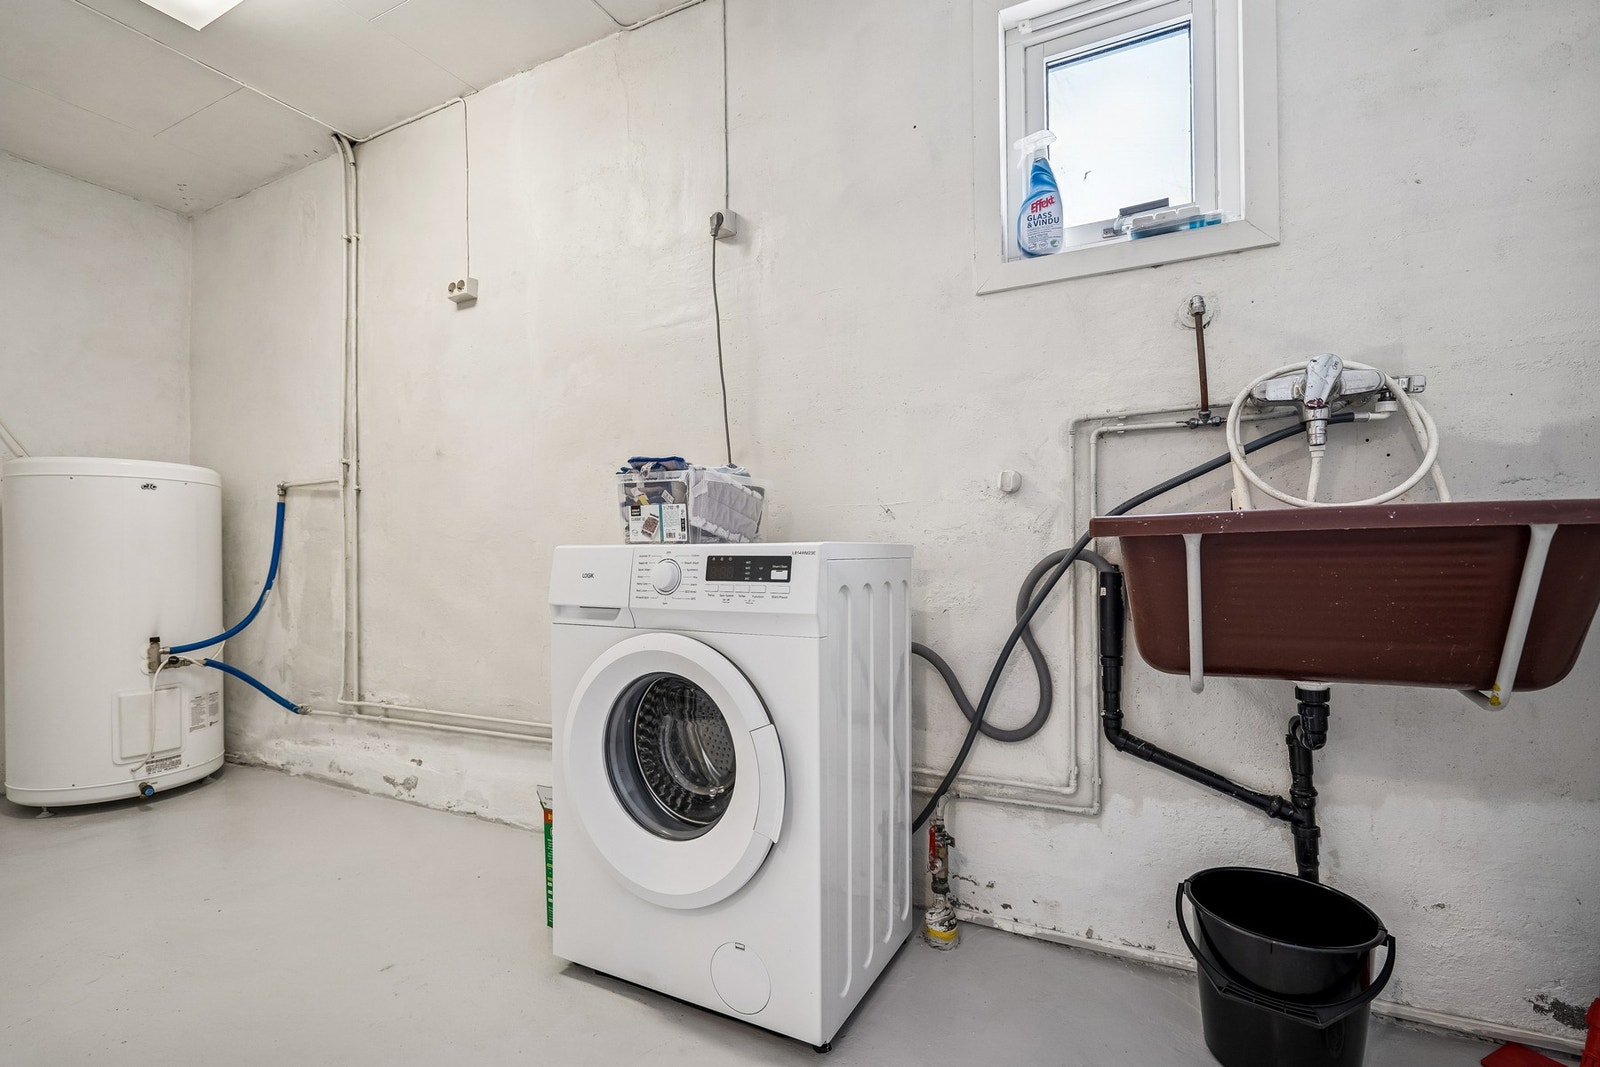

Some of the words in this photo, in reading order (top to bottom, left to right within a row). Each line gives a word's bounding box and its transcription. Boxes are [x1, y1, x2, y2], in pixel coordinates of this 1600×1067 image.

[1031, 196, 1055, 213] Effekt
[1027, 211, 1052, 222] GLASS
[1033, 217, 1059, 227] VINDU
